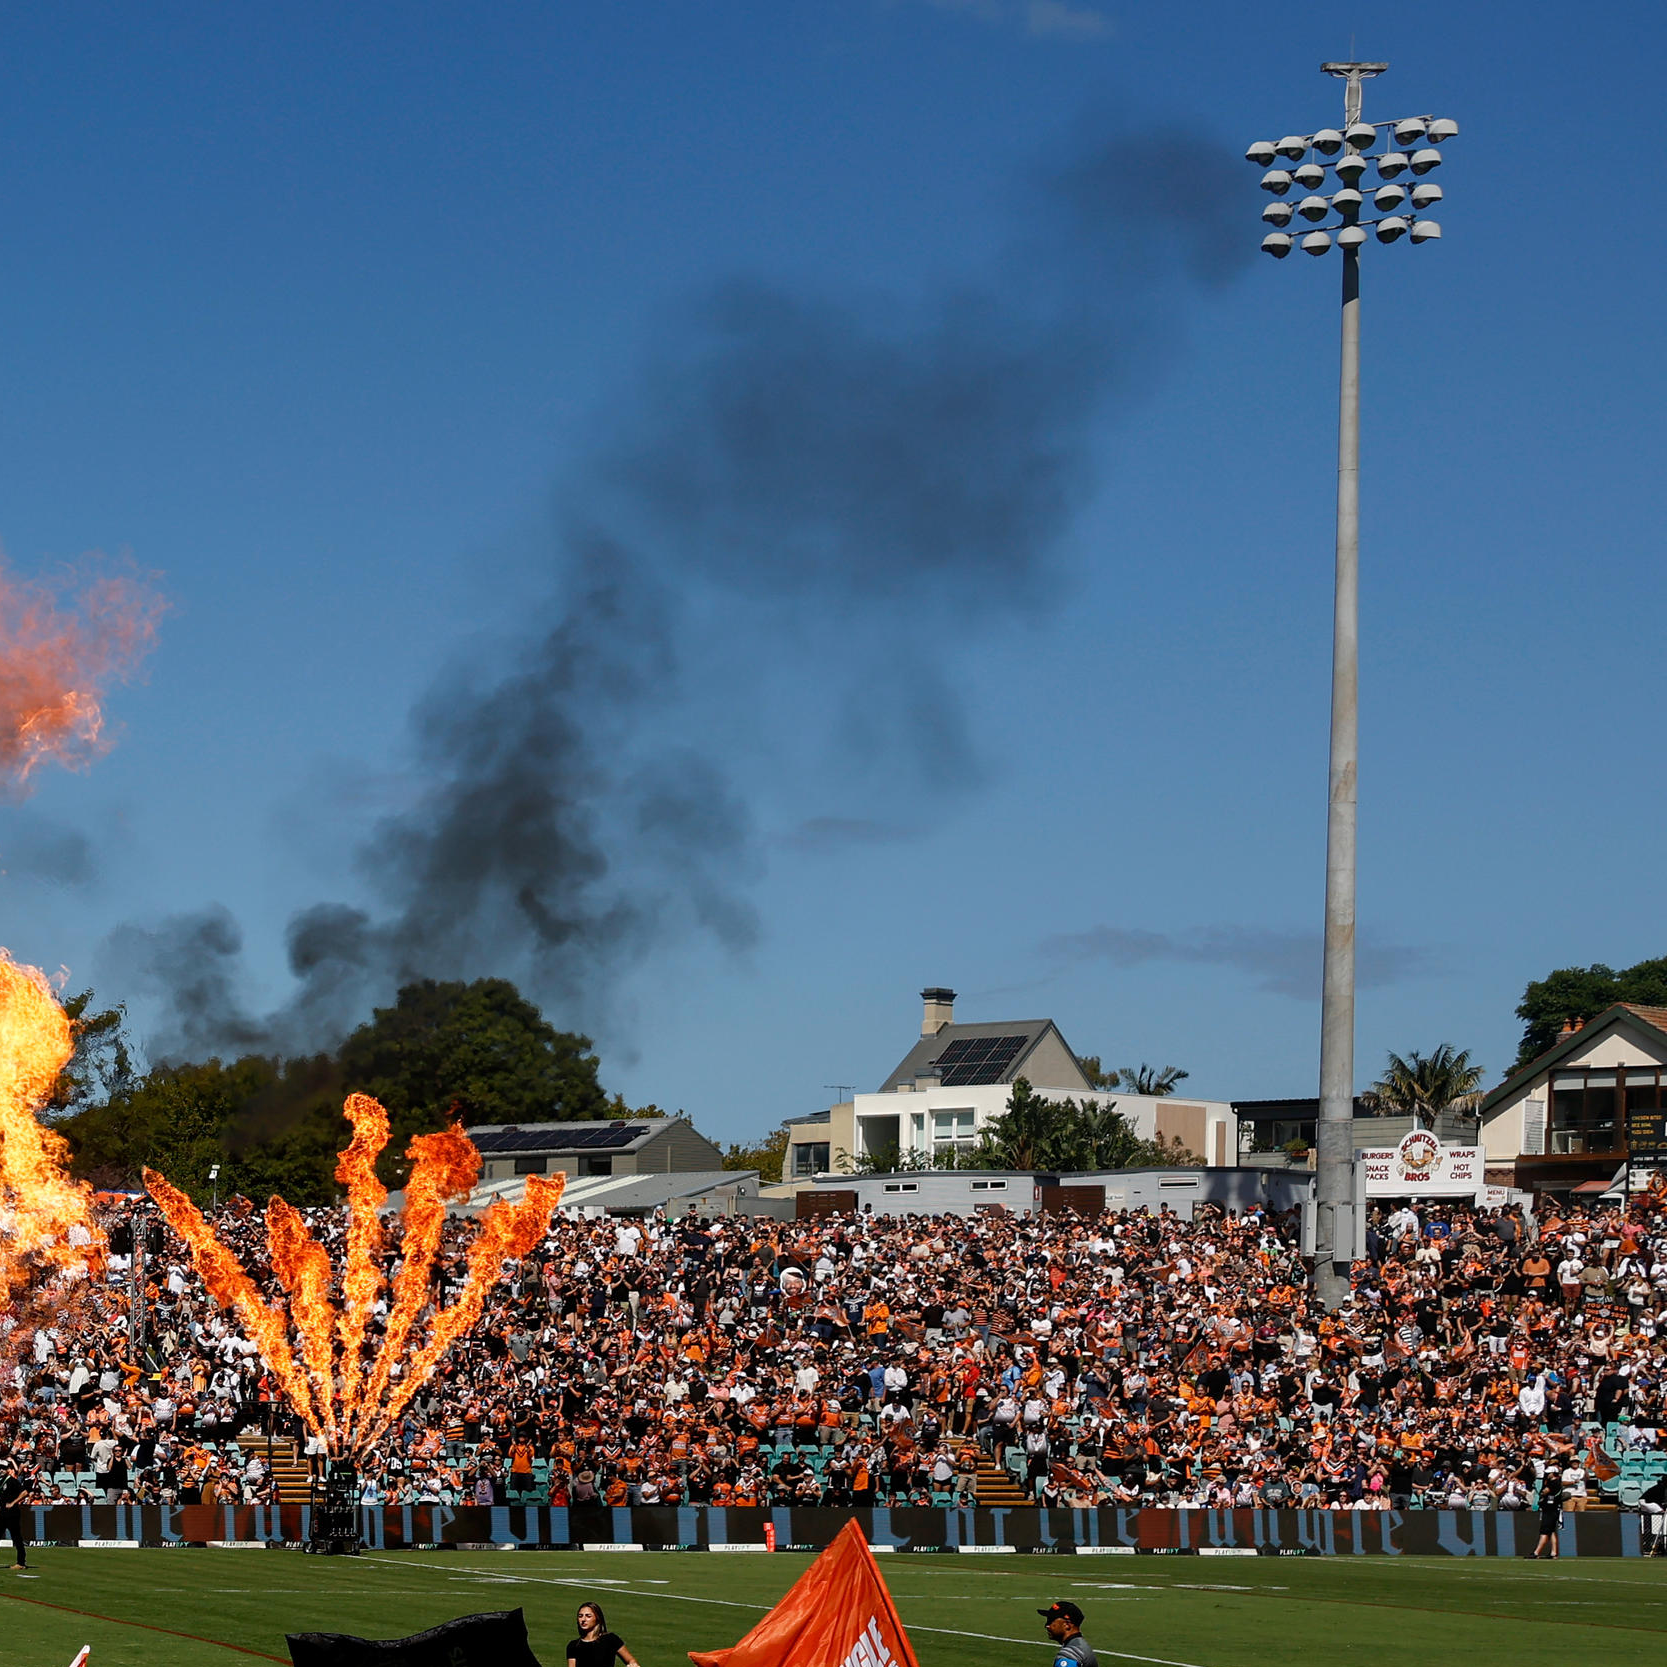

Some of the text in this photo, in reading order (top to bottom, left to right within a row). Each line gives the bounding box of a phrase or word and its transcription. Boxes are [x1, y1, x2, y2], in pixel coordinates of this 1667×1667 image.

[1362, 1152, 1394, 1160] BURGERS
[1449, 1151, 1476, 1159] WRAPS
[1453, 1164, 1469, 1172] HOT
[1404, 1172, 1431, 1182] BROS
[1450, 1172, 1473, 1181] CHIPS
[1487, 1188, 1505, 1196] MENU
